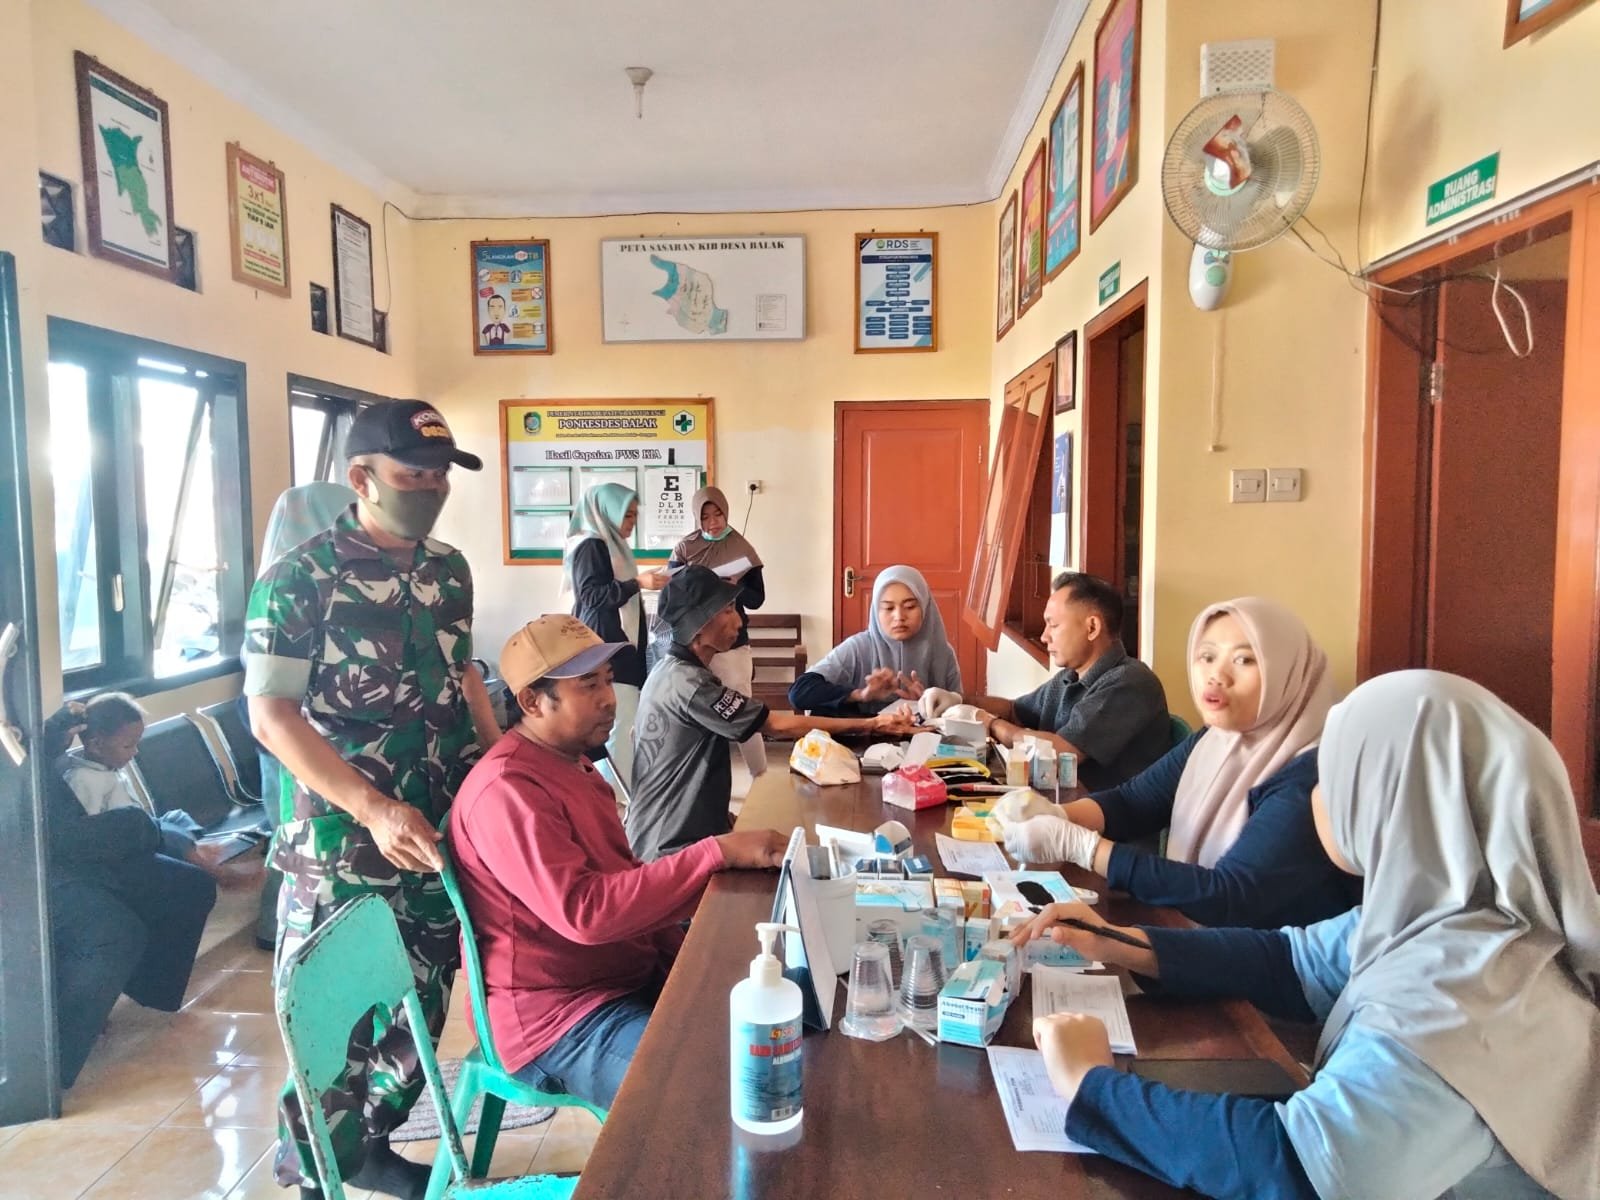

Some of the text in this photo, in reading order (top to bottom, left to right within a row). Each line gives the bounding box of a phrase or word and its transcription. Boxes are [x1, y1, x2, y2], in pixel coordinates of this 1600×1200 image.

[1444, 169, 1479, 199] RUANG
[1427, 176, 1496, 220] ADMINISTRASI
[620, 244, 647, 252] PETA
[650, 243, 695, 252] SASARAN
[721, 241, 746, 250] DESA
[750, 240, 785, 249] BALAK
[886, 240, 909, 249] RDS
[559, 417, 657, 429] PONKESDES BALAK
[545, 449, 662, 461] Hasil Capaian PWS KIA
[664, 475, 679, 491] E
